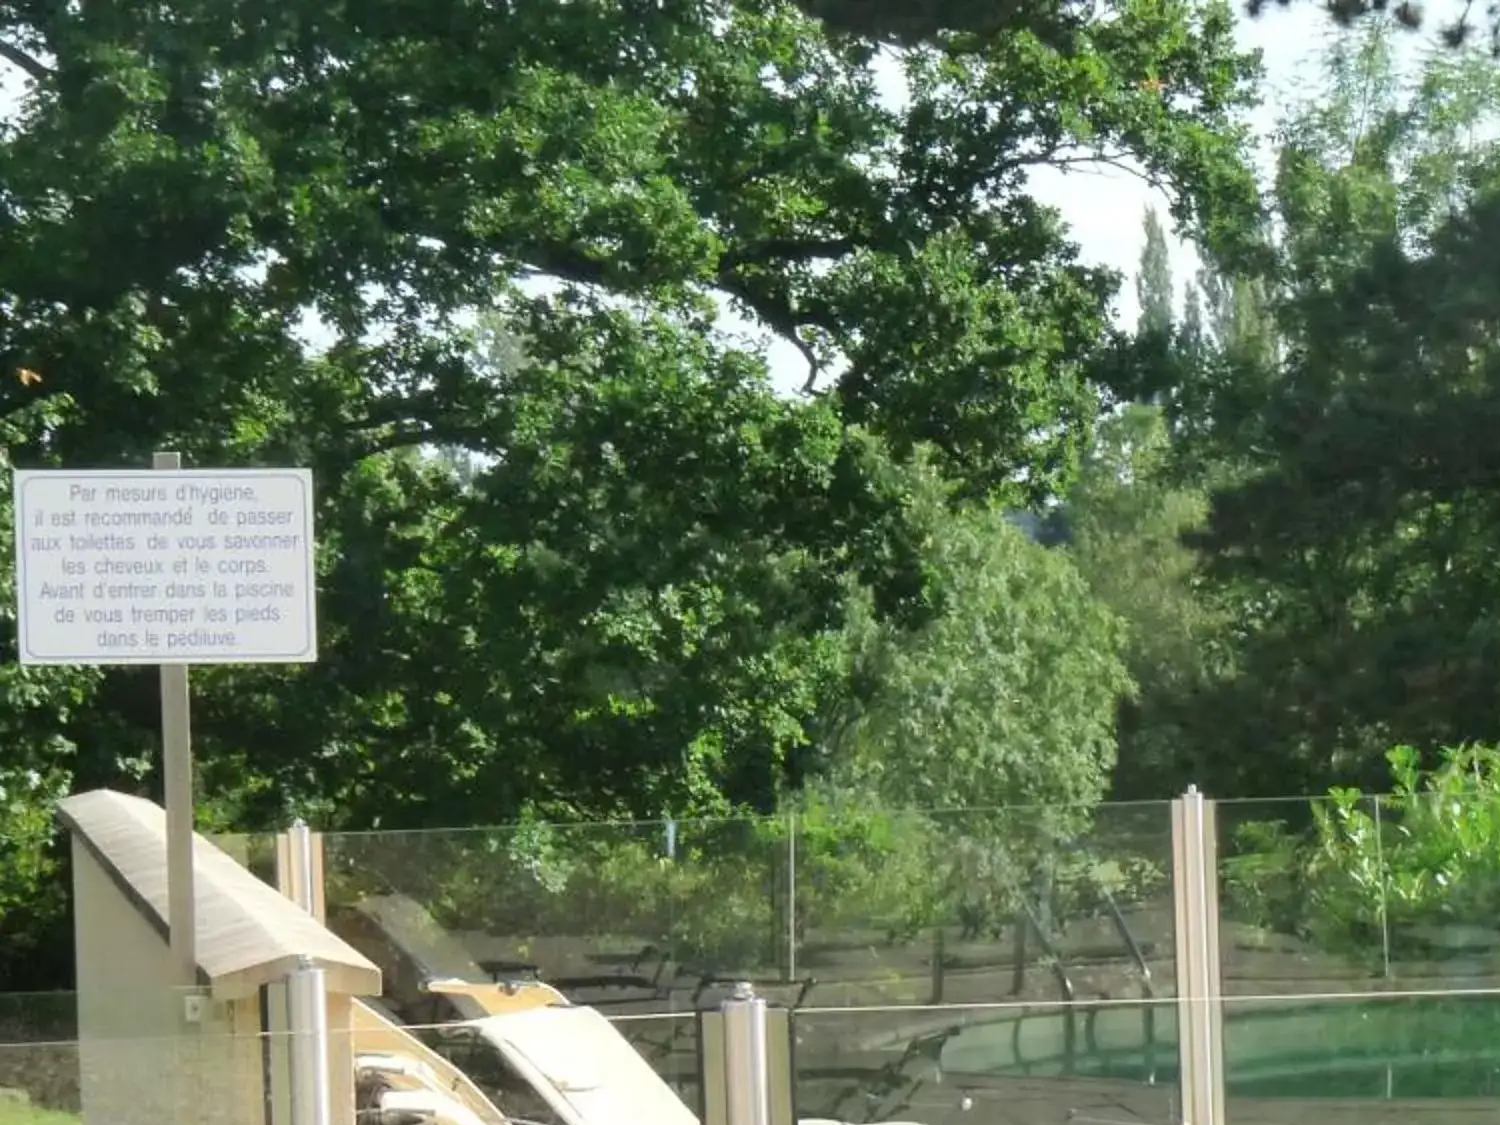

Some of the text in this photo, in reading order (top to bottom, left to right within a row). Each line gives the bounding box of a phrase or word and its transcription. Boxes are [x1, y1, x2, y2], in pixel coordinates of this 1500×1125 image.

[69, 484, 96, 501] Par
[105, 486, 167, 501] mesure
[34, 509, 43, 526] il
[50, 511, 76, 526] est
[207, 508, 228, 526] de
[237, 510, 293, 527] passer
[31, 537, 61, 551] aux
[147, 533, 170, 551] de
[178, 535, 216, 550] vous
[61, 557, 85, 575] les
[94, 556, 164, 575] cheveux
[173, 557, 188, 573] et
[195, 556, 209, 573] le
[40, 579, 295, 599] Avant d'entrer dans la piscine
[54, 605, 75, 623] de
[84, 607, 123, 623] vous
[131, 604, 195, 624] tremper
[203, 605, 227, 622] les
[97, 630, 139, 647] dans
[145, 628, 160, 647] le
